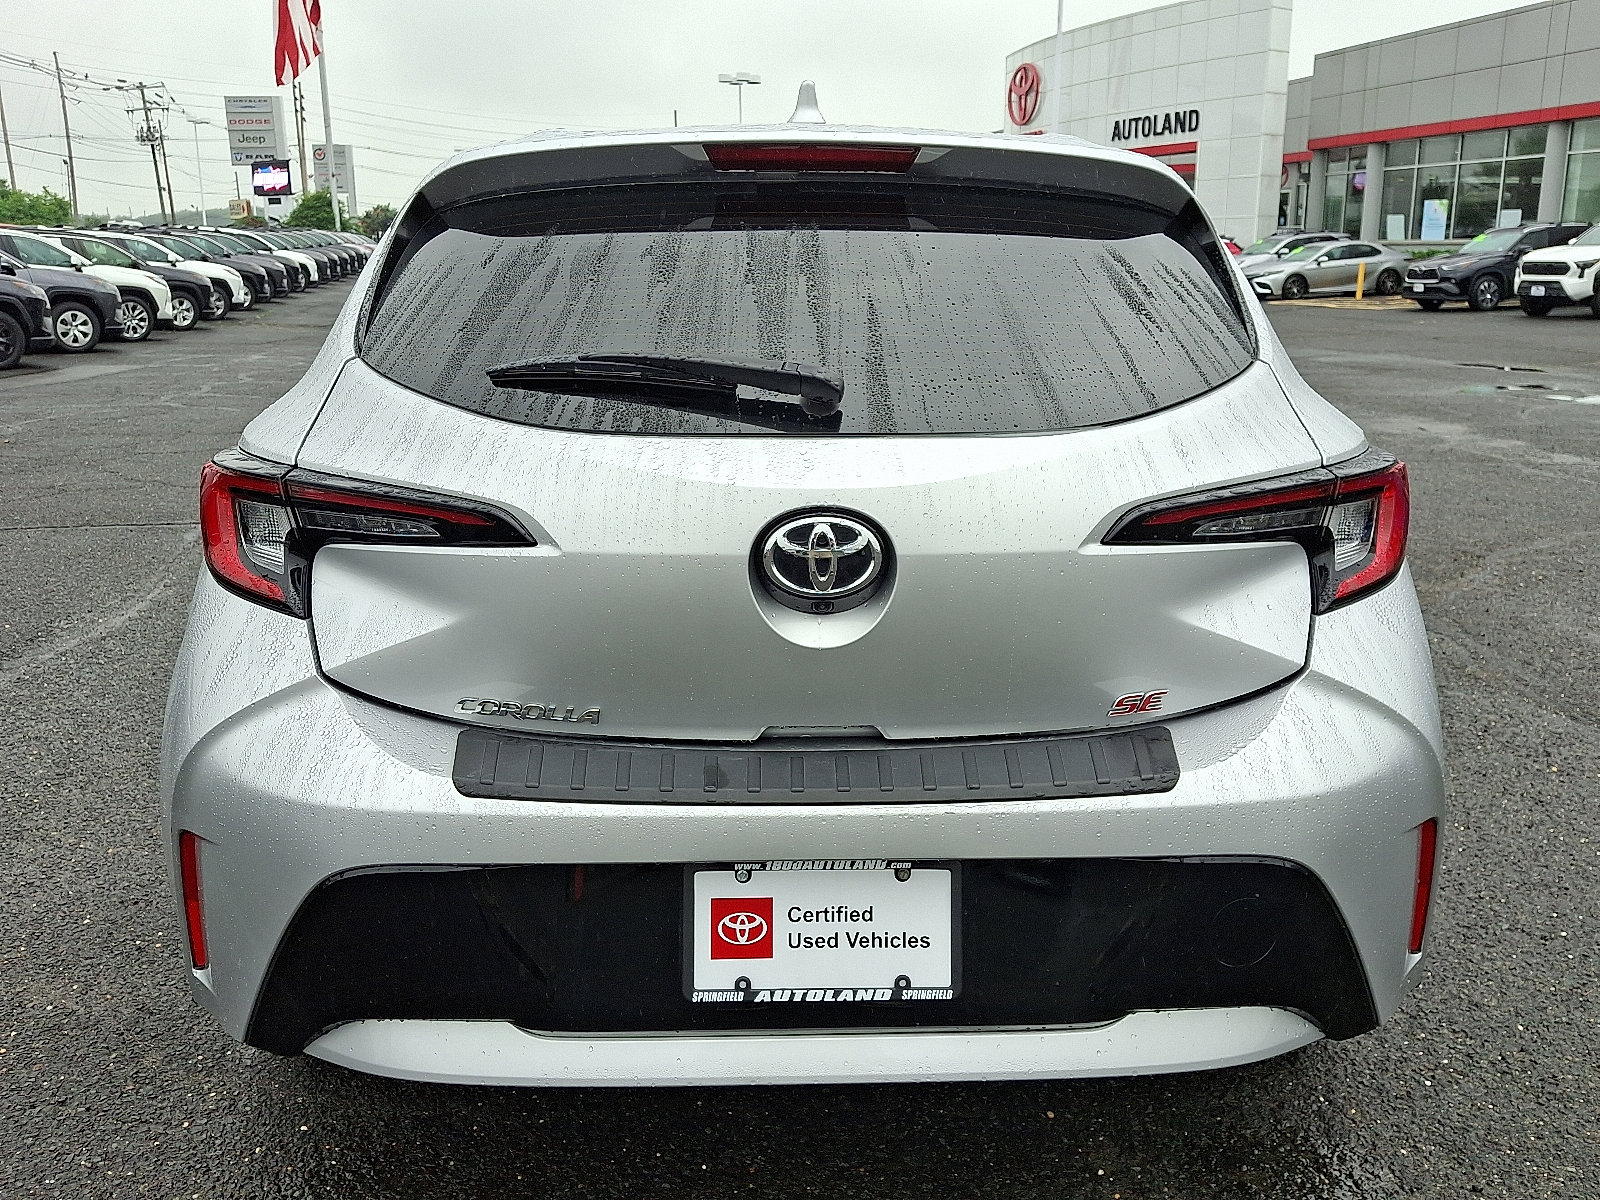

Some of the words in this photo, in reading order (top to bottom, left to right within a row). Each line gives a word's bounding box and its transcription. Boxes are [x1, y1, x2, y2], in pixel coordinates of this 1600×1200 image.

[1111, 110, 1199, 141] AUTOLAND
[238, 133, 266, 144] Jeep
[453, 696, 601, 726] COROLLA
[1107, 688, 1170, 717] SE
[787, 905, 874, 923] Certified
[787, 931, 839, 949] Used
[845, 931, 931, 949] Vehicles
[691, 990, 746, 1002] SPRINGFIELD
[753, 989, 893, 1002] AUTOLAND
[901, 988, 954, 1001] SPRINGFIELD
